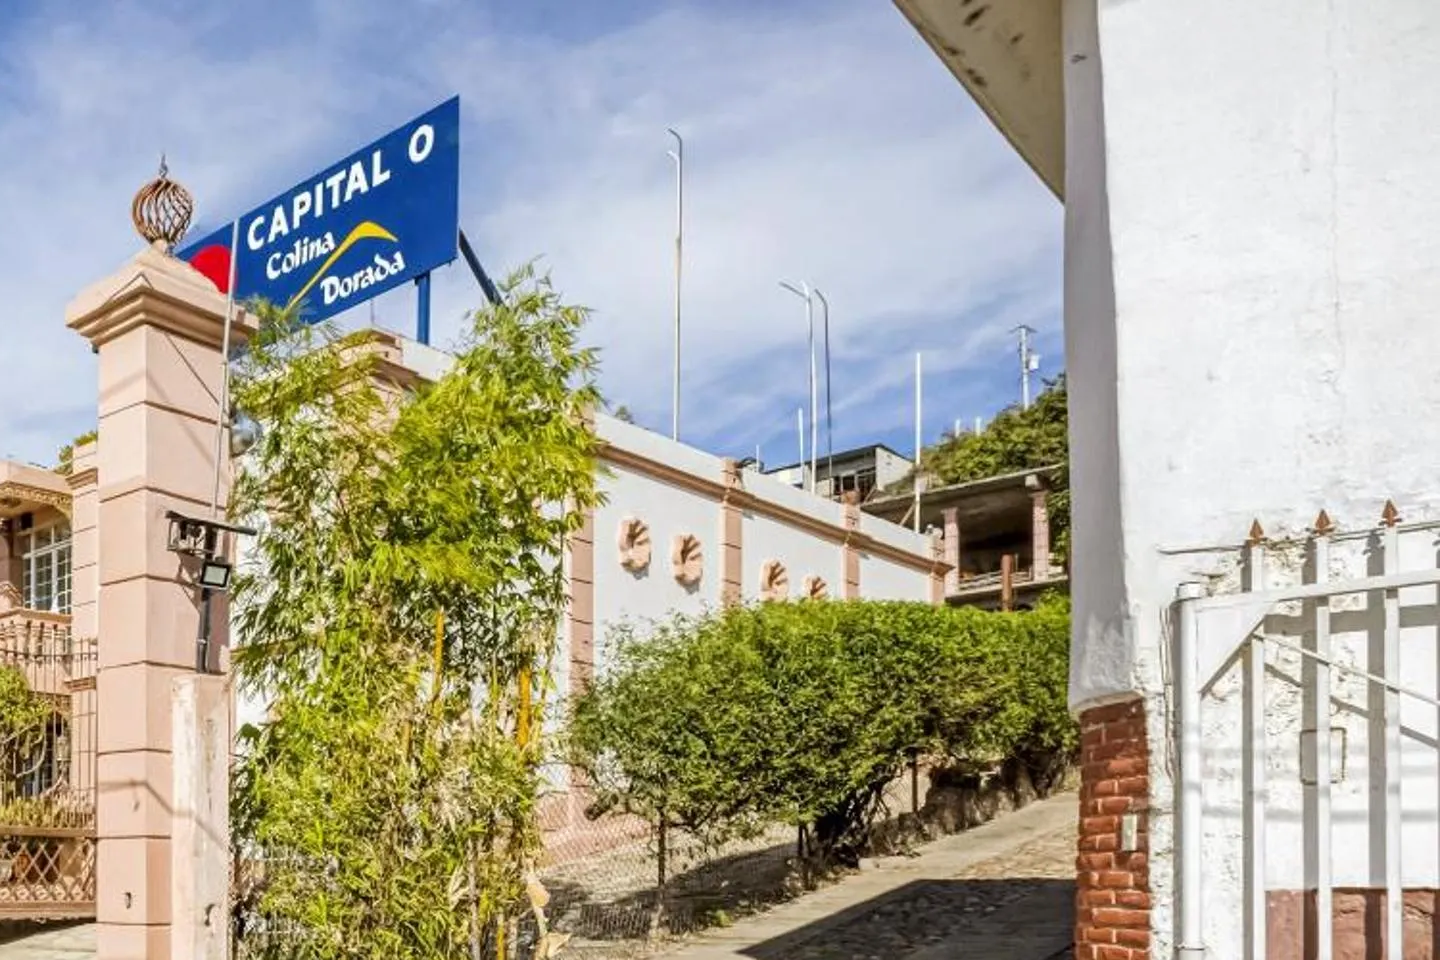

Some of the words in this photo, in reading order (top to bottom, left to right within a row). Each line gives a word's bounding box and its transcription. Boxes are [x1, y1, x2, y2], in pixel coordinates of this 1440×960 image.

[247, 149, 391, 250] CAPITAL
[408, 124, 435, 163] O
[266, 231, 336, 280] Colina
[320, 251, 406, 304] Dorada
